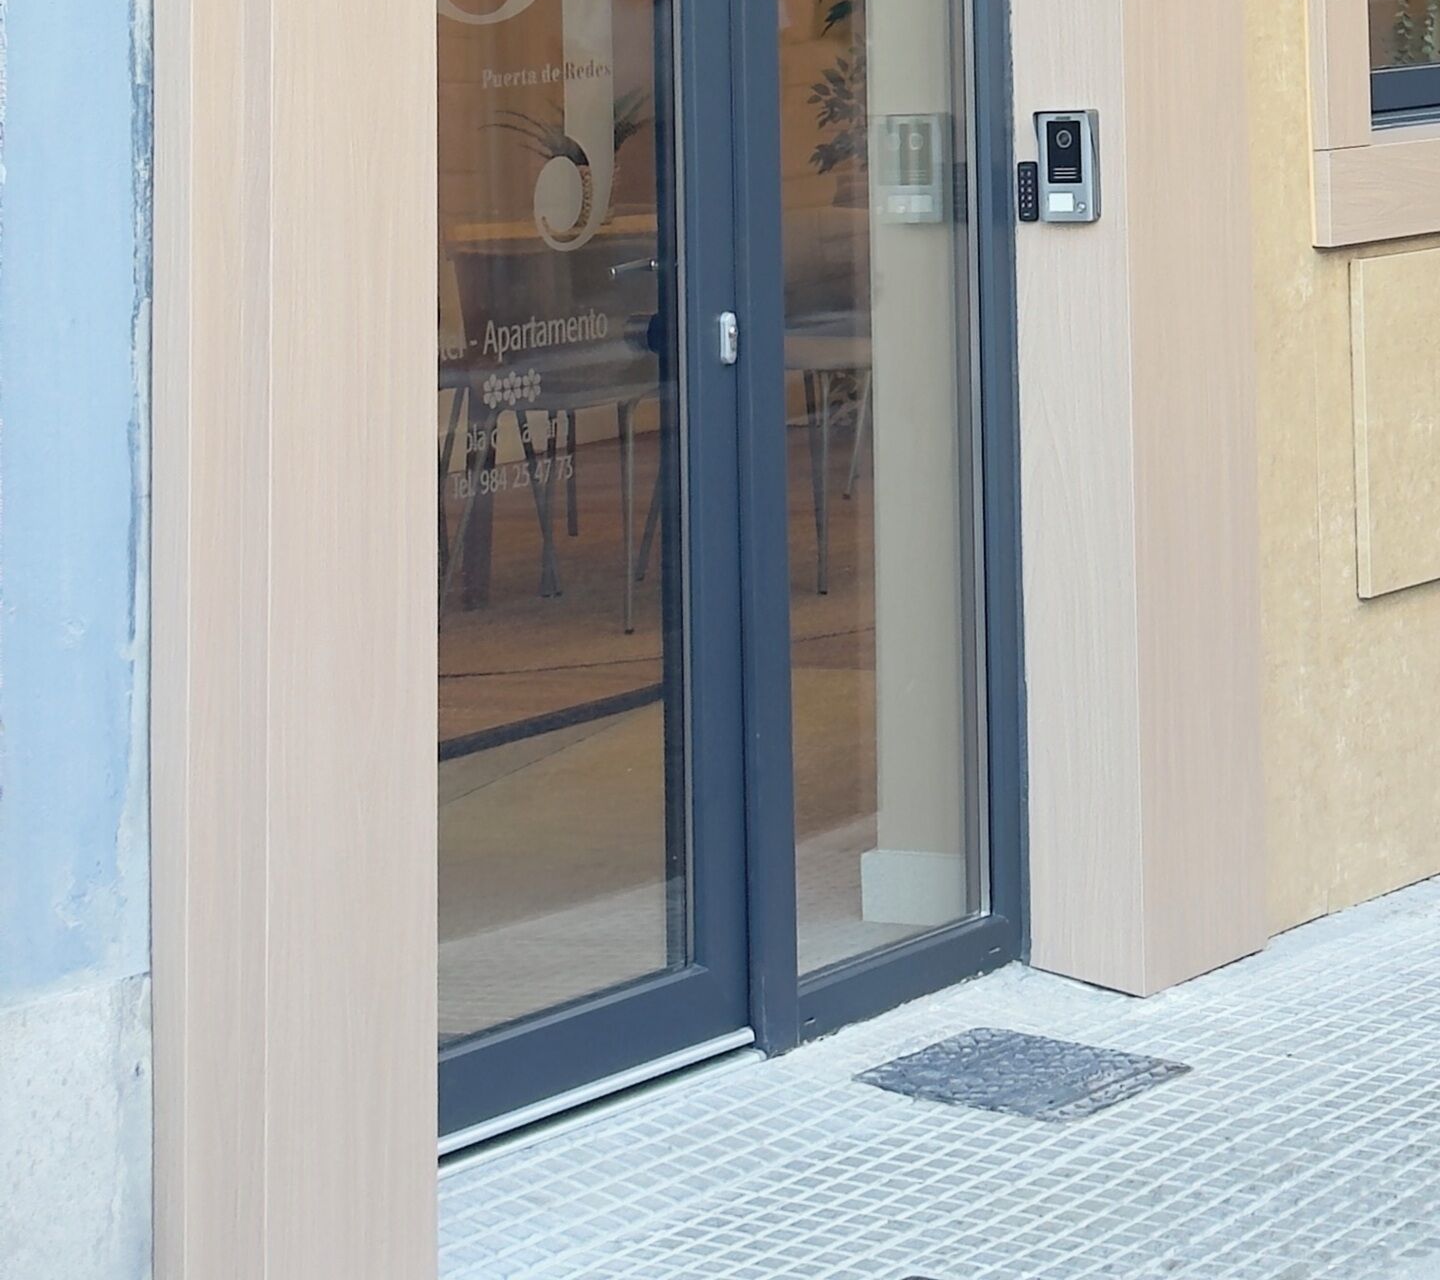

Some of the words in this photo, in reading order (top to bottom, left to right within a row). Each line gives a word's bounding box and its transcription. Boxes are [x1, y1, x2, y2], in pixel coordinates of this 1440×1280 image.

[482, 68, 538, 89] Puerta
[541, 63, 561, 83] de
[565, 59, 612, 80] Redes
[483, 308, 608, 362] Apartamento
[480, 466, 507, 495] 984
[512, 462, 530, 488] 25
[534, 458, 552, 486] 47
[556, 454, 574, 482] 73
